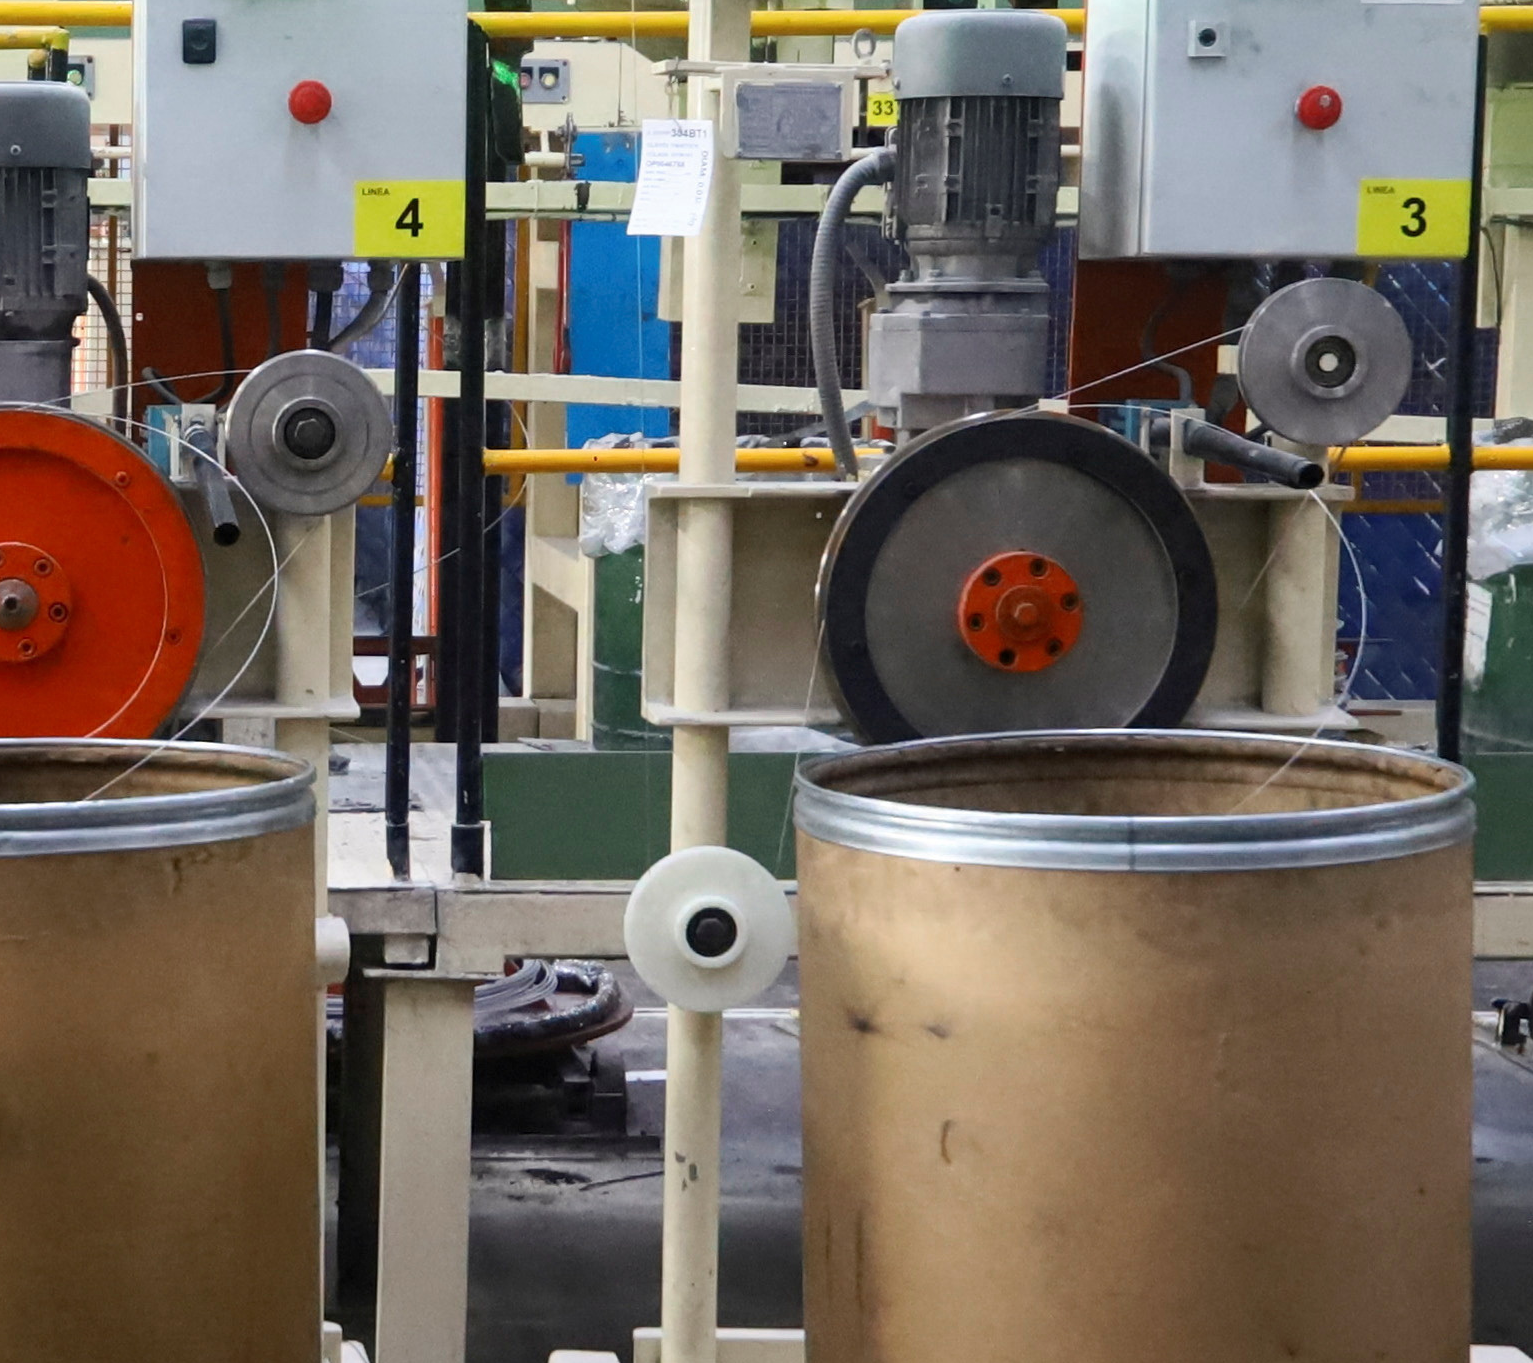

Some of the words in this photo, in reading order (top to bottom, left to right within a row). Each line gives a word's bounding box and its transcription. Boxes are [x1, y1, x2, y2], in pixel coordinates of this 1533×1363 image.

[872, 100, 894, 116] 33
[361, 187, 391, 196] LINEA
[394, 197, 425, 238] 4
[1400, 196, 1427, 238] 3
